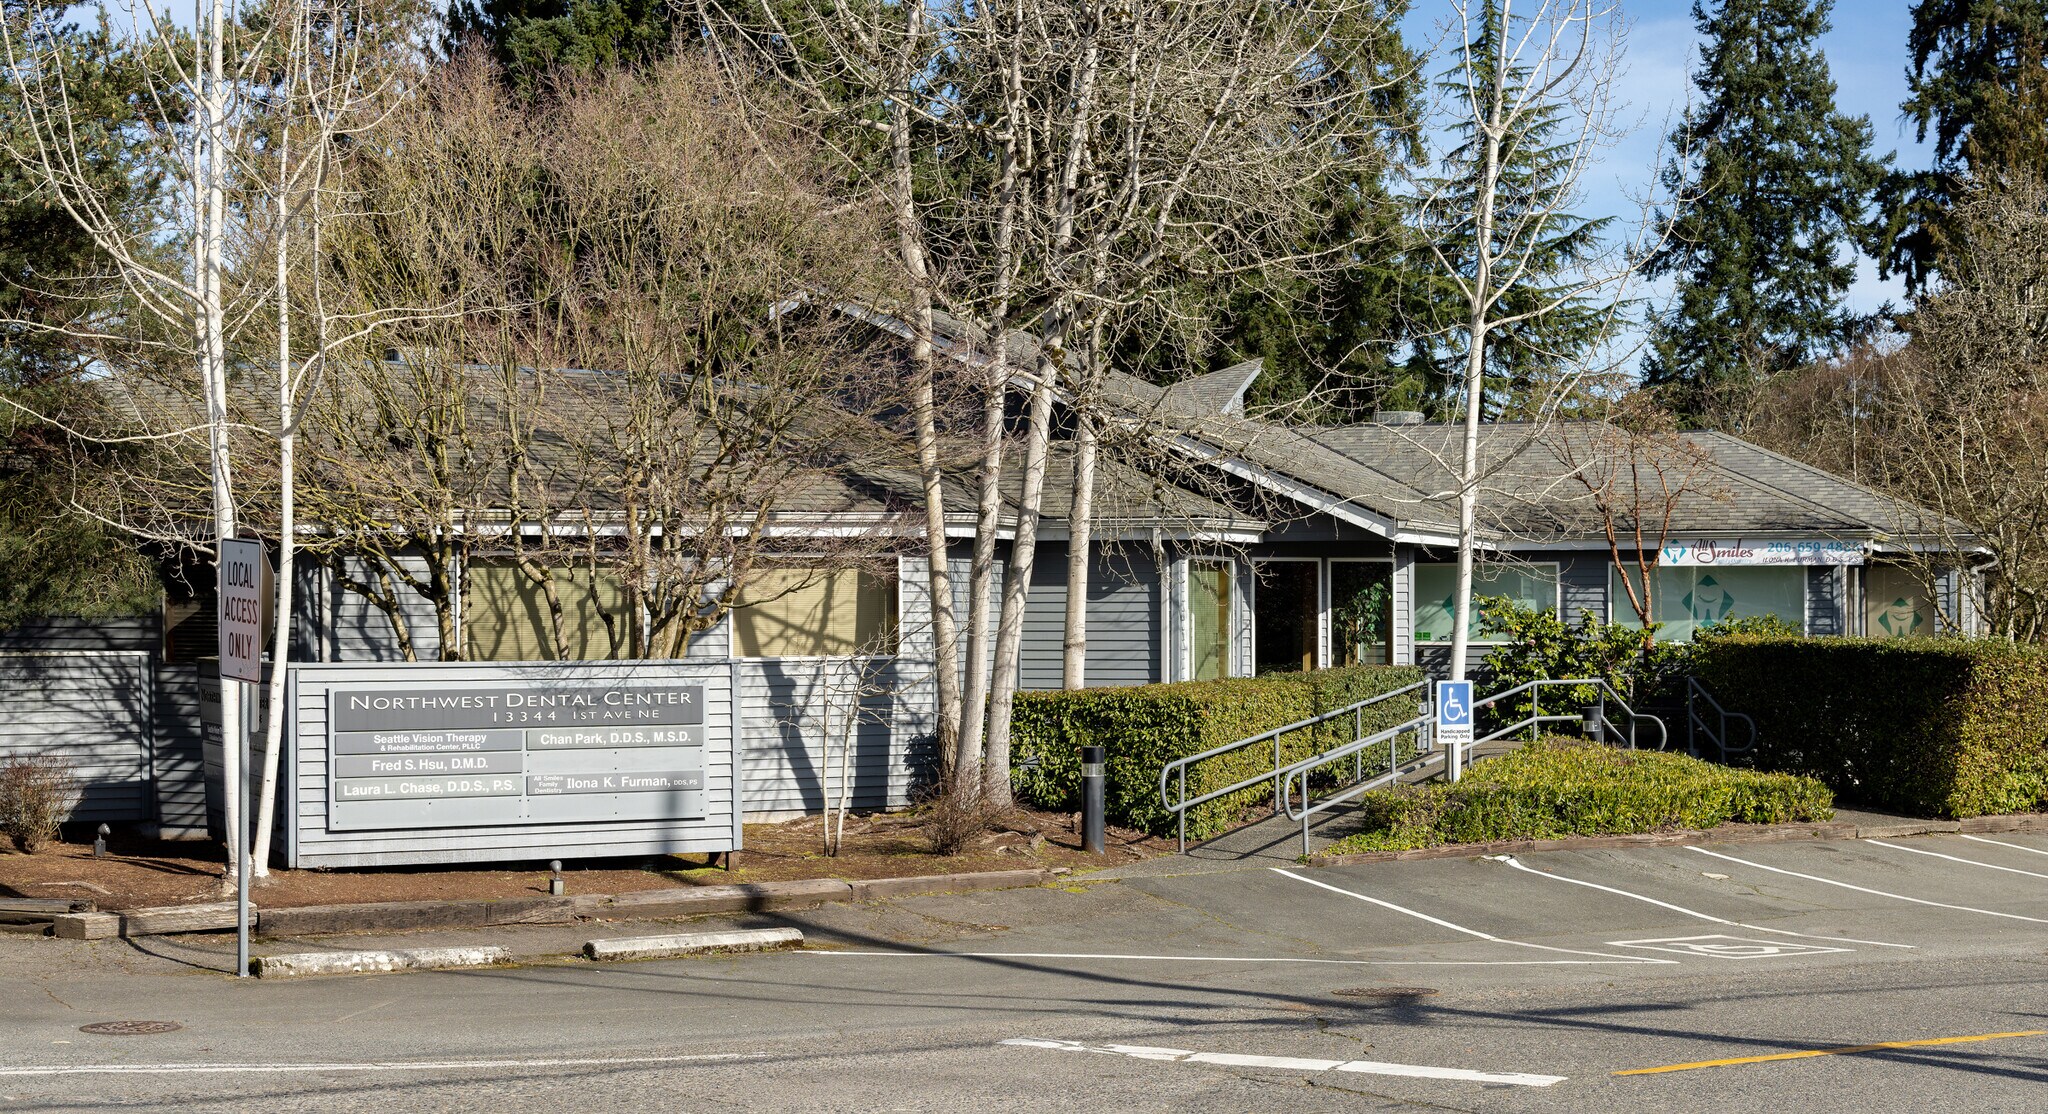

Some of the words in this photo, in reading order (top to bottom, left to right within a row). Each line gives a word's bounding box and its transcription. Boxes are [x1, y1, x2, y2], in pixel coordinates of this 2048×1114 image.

[1697, 538, 1753, 563] Smiles
[227, 561, 254, 589] LOCAL
[224, 596, 258, 625] ACCESS
[228, 632, 252, 660] ONLY
[350, 695, 499, 710] NORTHWEST
[506, 691, 597, 707] DENTAL
[604, 691, 692, 706] CENTER
[493, 711, 557, 722] 13344
[572, 711, 597, 720] 1ST
[603, 710, 632, 719] AVE
[638, 710, 660, 719] NE
[373, 734, 410, 744] Seattle
[412, 733, 443, 743] Vision
[446, 733, 487, 743] Therapy
[540, 734, 572, 745] Chan
[575, 733, 607, 745] Park,
[610, 733, 650, 743] D.D.S.,
[653, 731, 691, 742] M.S.D.
[387, 743, 435, 751] Rehabilitation
[436, 743, 461, 751] Center,
[372, 760, 401, 771] Fred
[404, 760, 417, 770] S.
[419, 759, 448, 771] Hsu,
[451, 758, 489, 769] D.M.D.
[344, 784, 381, 796] Laura
[384, 784, 396, 795] L.
[400, 783, 443, 795] Chase,
[447, 781, 489, 793] D.D.S.,
[493, 780, 516, 791] P.S.
[567, 777, 598, 789] Ilona
[603, 777, 617, 787] K.
[621, 776, 671, 788] Furman,
